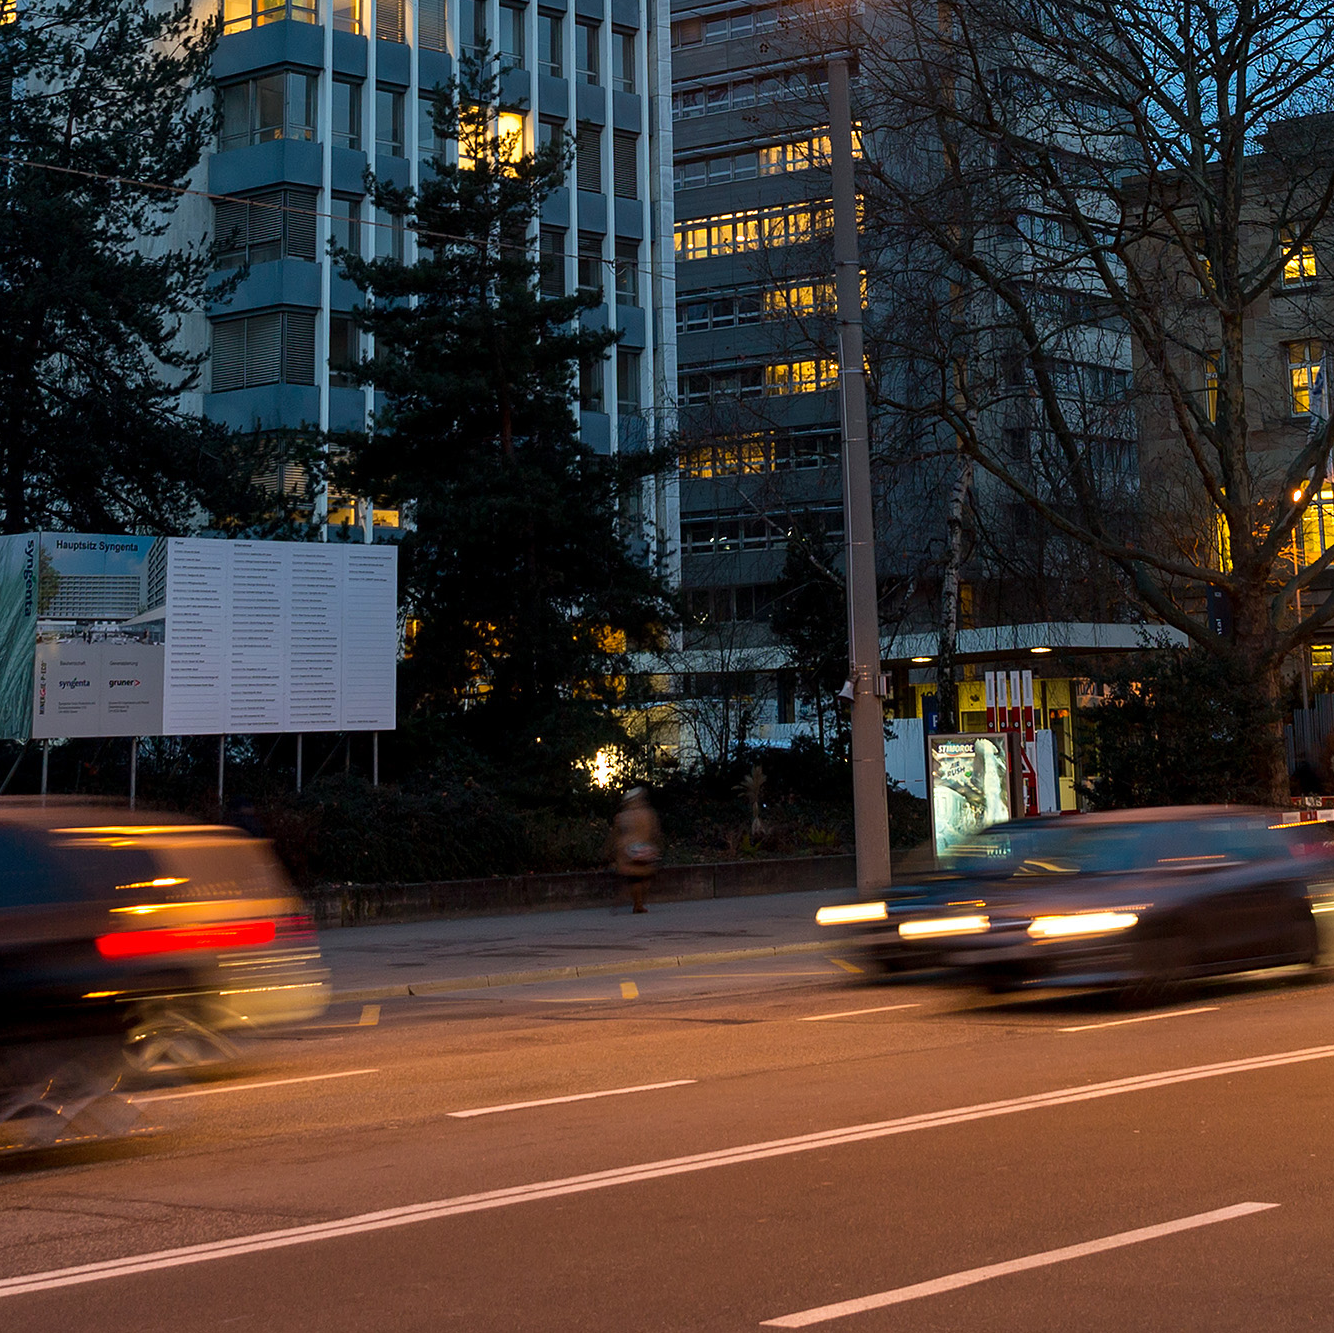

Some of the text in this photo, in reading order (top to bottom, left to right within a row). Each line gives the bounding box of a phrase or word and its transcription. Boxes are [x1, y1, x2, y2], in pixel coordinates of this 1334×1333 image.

[56, 539, 138, 553] Hauptsitz Syngenta
[23, 539, 35, 617] syngenta
[58, 678, 90, 689] syngenta
[108, 679, 134, 688] gruner
[938, 745, 975, 754] STIMOROL
